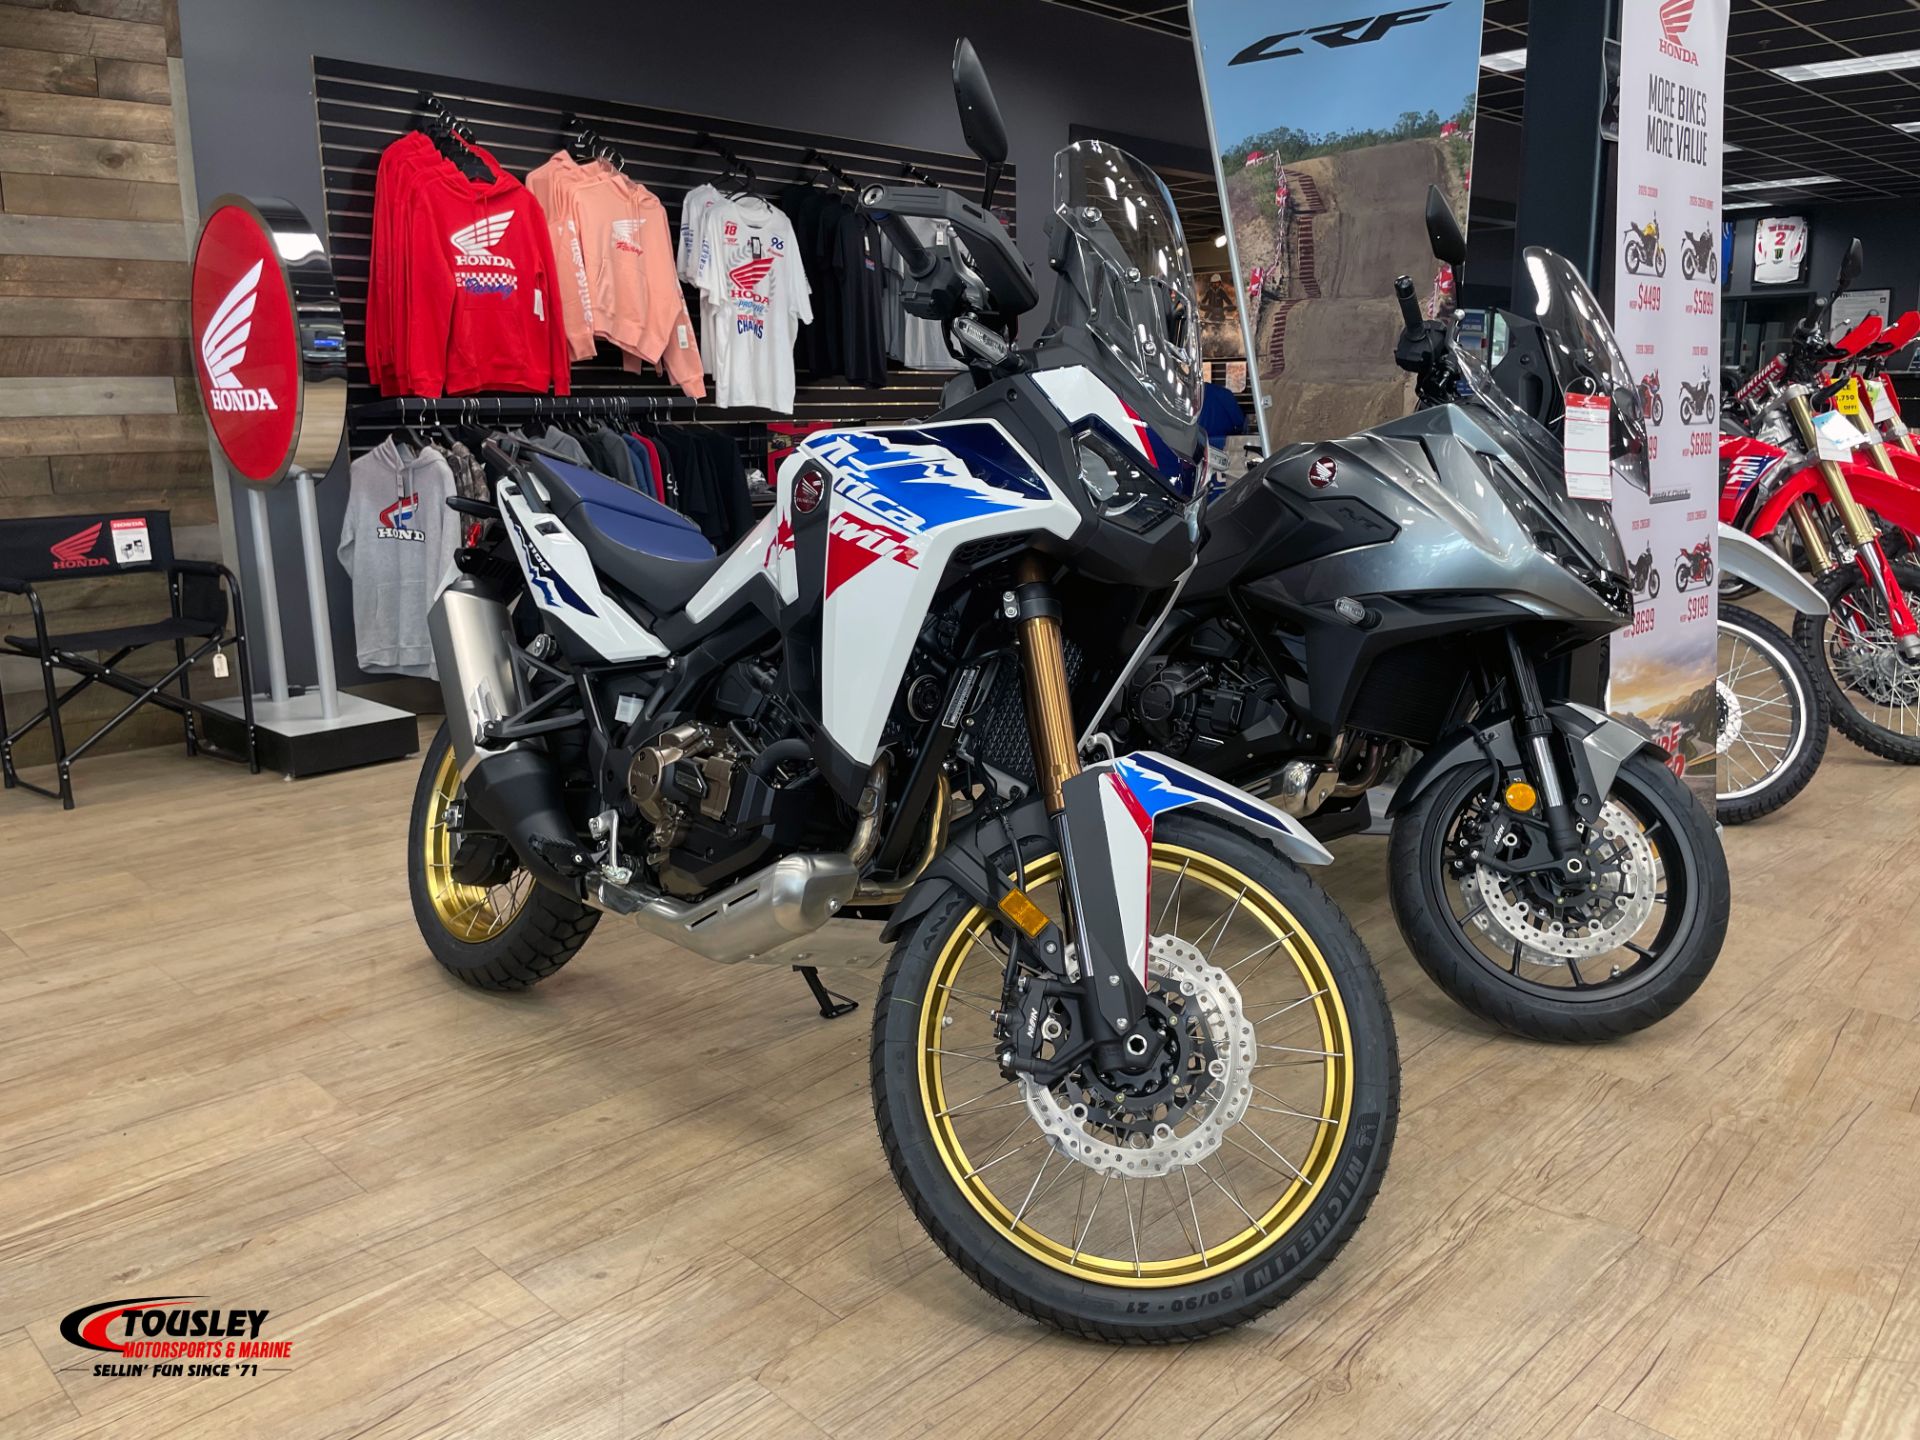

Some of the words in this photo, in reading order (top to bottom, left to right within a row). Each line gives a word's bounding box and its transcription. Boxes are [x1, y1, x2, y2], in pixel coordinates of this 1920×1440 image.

[1228, 2, 1452, 66] CRF
[1659, 38, 1699, 66] HONDA
[1648, 73, 1675, 118] MORE
[1678, 85, 1707, 127] BIKES
[1646, 115, 1674, 158] MORE
[1676, 124, 1708, 167] VALUE
[725, 224, 738, 236] 18
[770, 236, 784, 251] 96
[1775, 231, 1786, 245] 2
[455, 255, 516, 270] HONDA
[1638, 282, 1661, 312] $4499
[210, 387, 279, 412] HONDA
[1690, 432, 1712, 457] $6899
[377, 528, 425, 542] HOND
[53, 557, 110, 570] HONDA
[528, 542, 551, 572] 1100
[1687, 595, 1709, 622] $9199
[1253, 1155, 1366, 1290] MICHELIN
[1126, 1302, 1149, 1314] 21
[1170, 1286, 1233, 1313] 90/90
